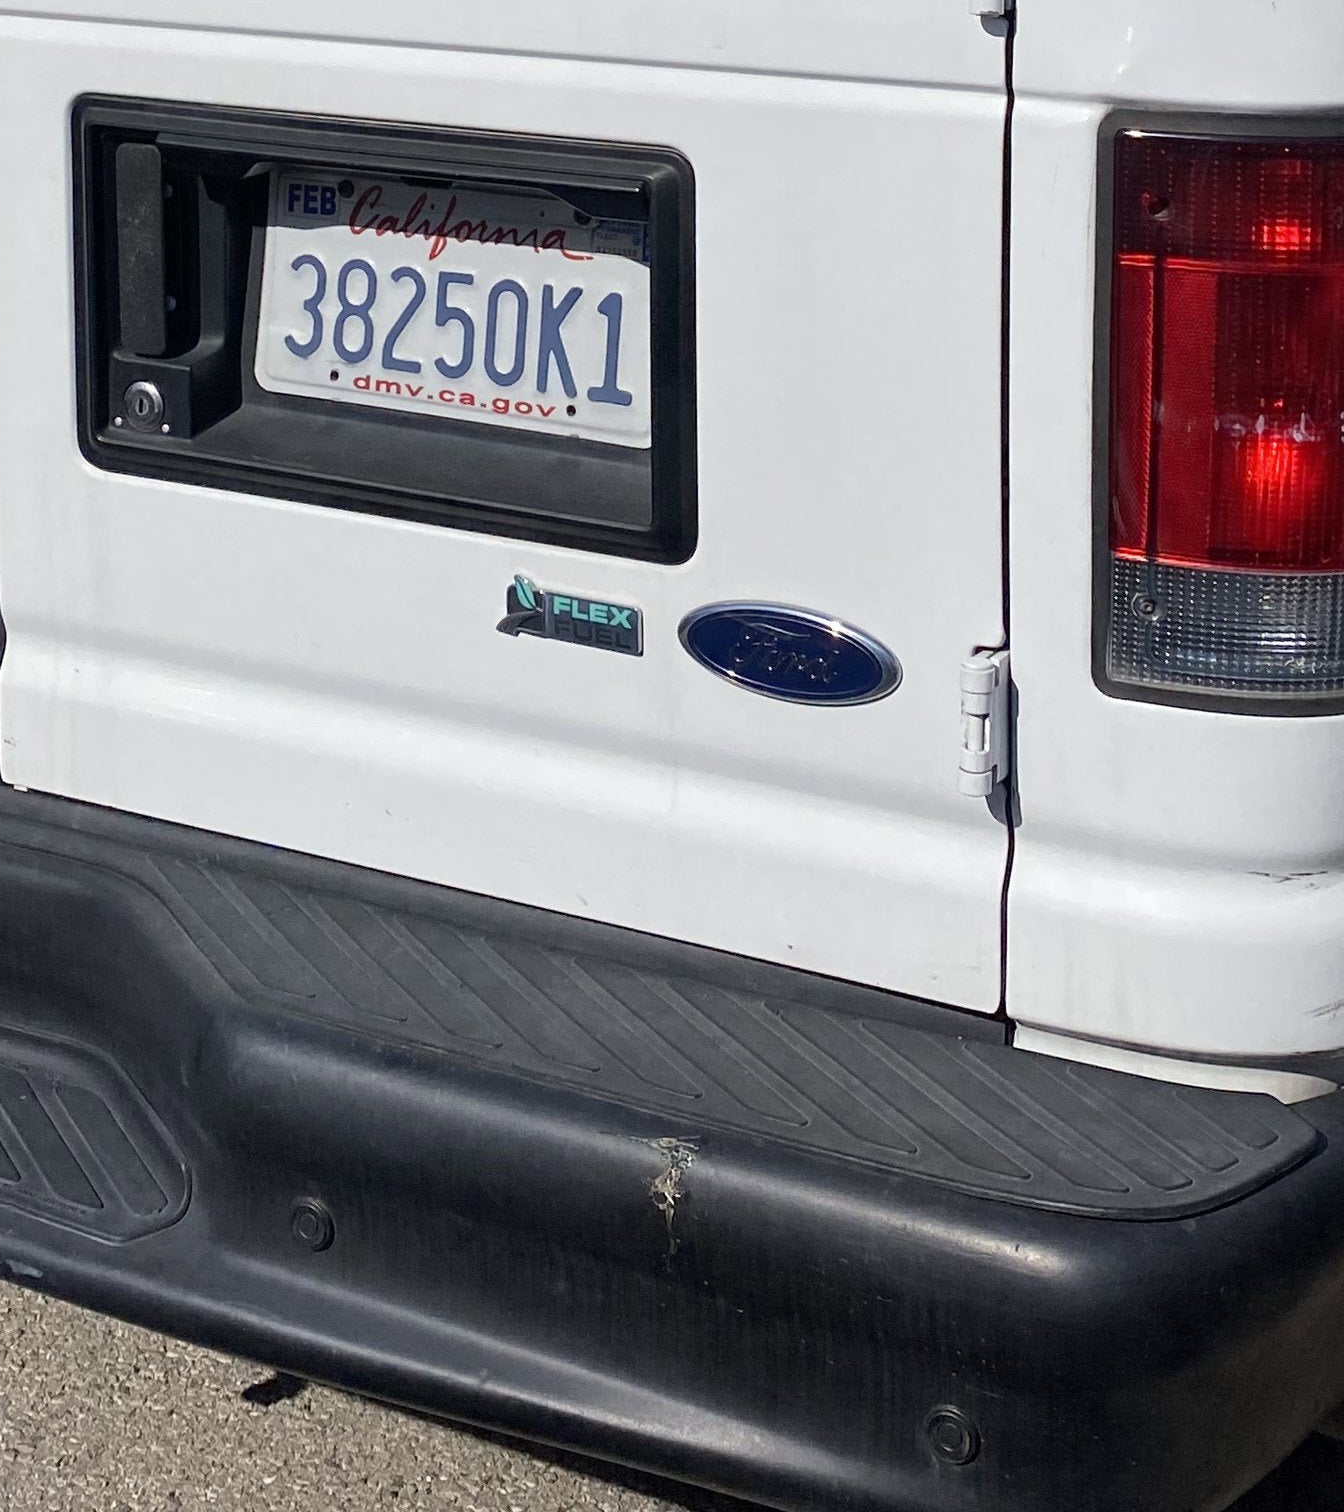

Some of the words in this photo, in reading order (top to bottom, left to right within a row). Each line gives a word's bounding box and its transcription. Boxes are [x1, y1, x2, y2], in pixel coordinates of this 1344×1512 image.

[288, 183, 337, 216] FEB
[349, 184, 594, 260] California
[284, 254, 633, 406] 38250K1
[353, 375, 556, 418] dmv.ca.gov
[553, 595, 633, 630] FLEX
[554, 623, 632, 650] FUEL
